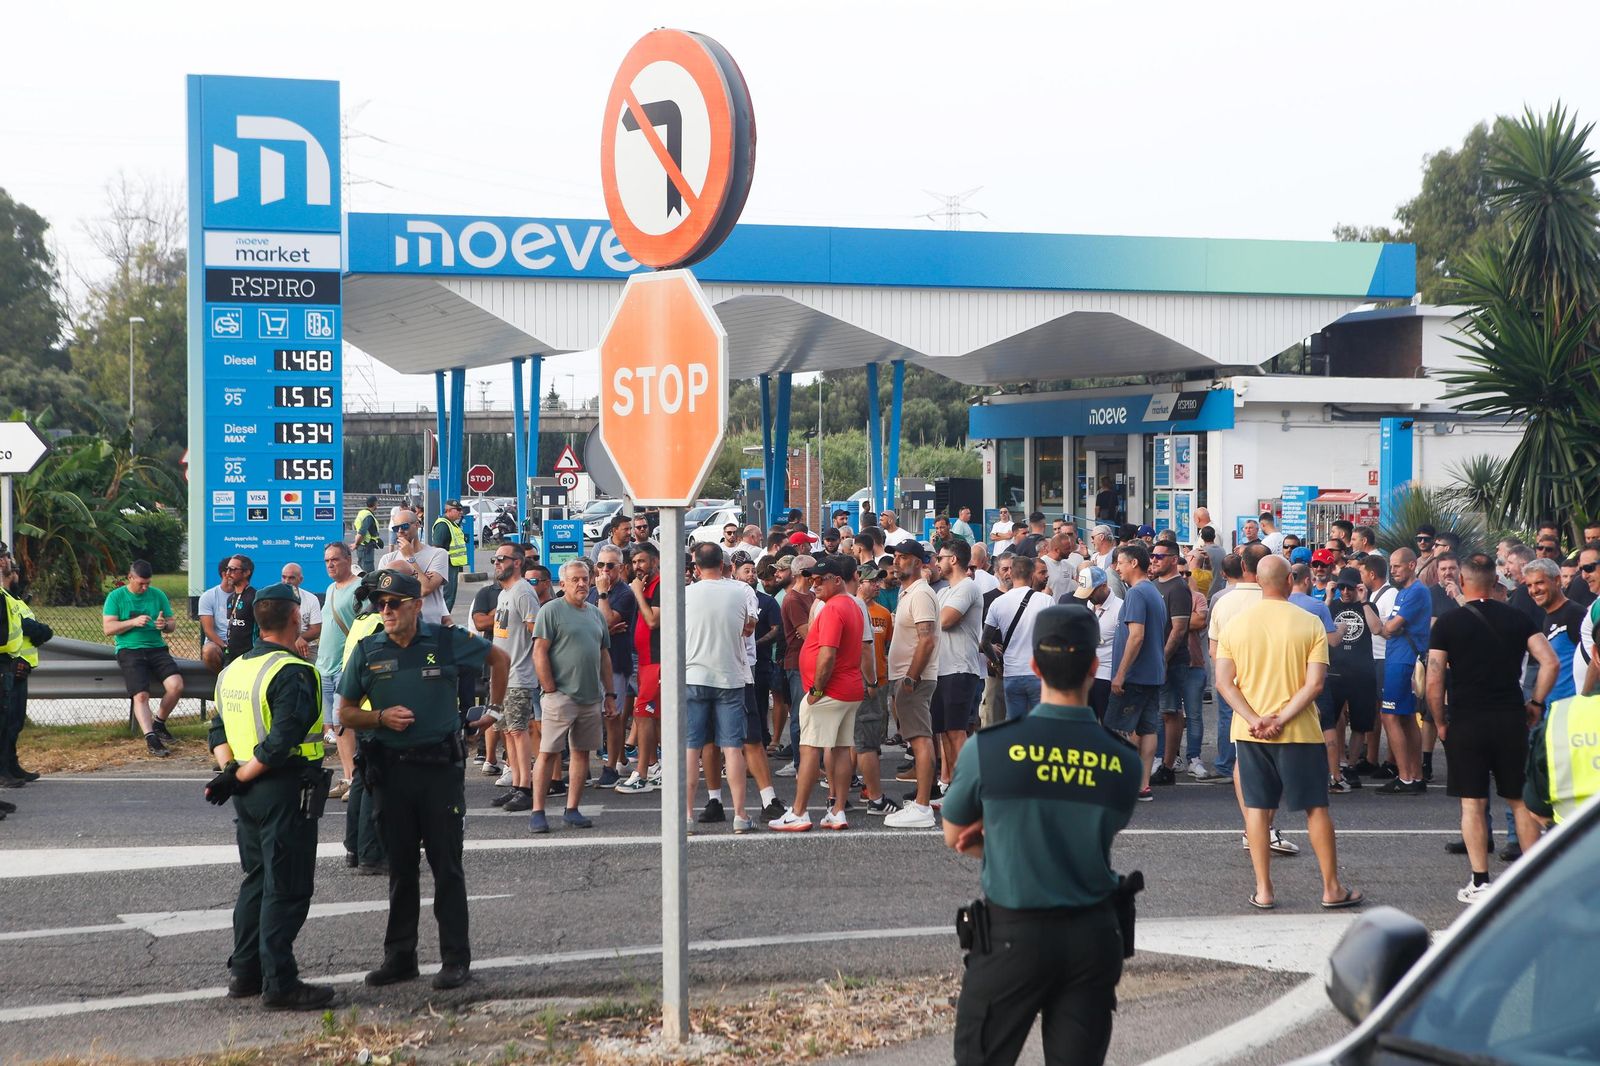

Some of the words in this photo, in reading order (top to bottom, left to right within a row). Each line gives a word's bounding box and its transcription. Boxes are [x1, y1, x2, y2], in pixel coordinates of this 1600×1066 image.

[235, 246, 310, 263] market
[231, 275, 316, 298] R'SPIRO
[224, 355, 256, 365] Diesel
[282, 350, 332, 371] 1.468
[612, 363, 709, 417] STOP
[224, 393, 242, 406] 95
[1089, 406, 1127, 425] moeve
[1151, 406, 1169, 415] market
[224, 423, 257, 434] Diesel
[282, 423, 332, 444] 1.534
[224, 462, 242, 475] 95
[282, 459, 333, 480] 1.556
[222, 689, 250, 700] GUARDIA
[226, 702, 243, 713] CIVIL
[1008, 744, 1123, 774] GUARDIA
[1036, 764, 1097, 787] CIVIL
